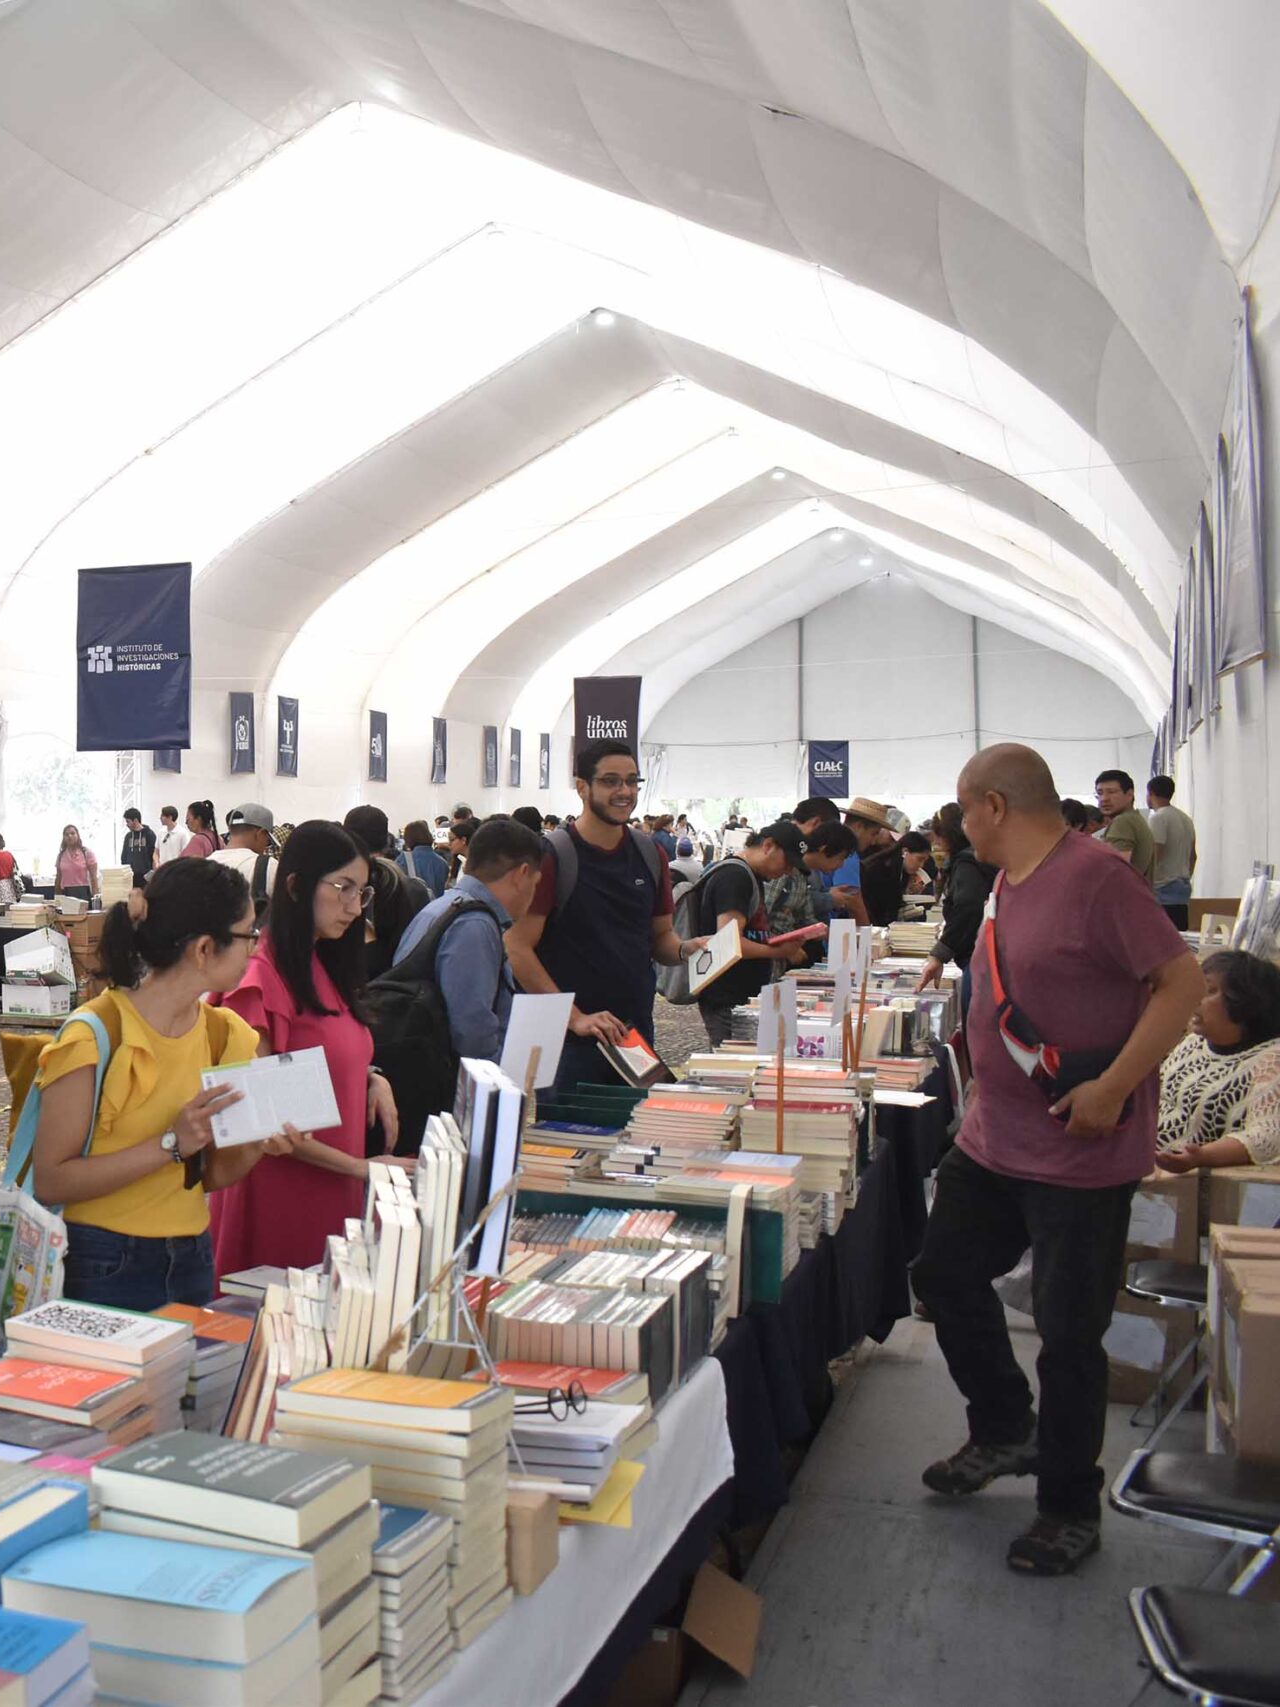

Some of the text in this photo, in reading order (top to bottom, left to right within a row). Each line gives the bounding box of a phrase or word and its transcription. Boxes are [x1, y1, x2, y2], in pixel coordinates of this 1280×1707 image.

[117, 643, 163, 653] INSTITUTO DE
[116, 652, 179, 662] INVESTIGACIONES
[117, 662, 161, 672] HISTÓRICAS
[587, 715, 628, 729] libros
